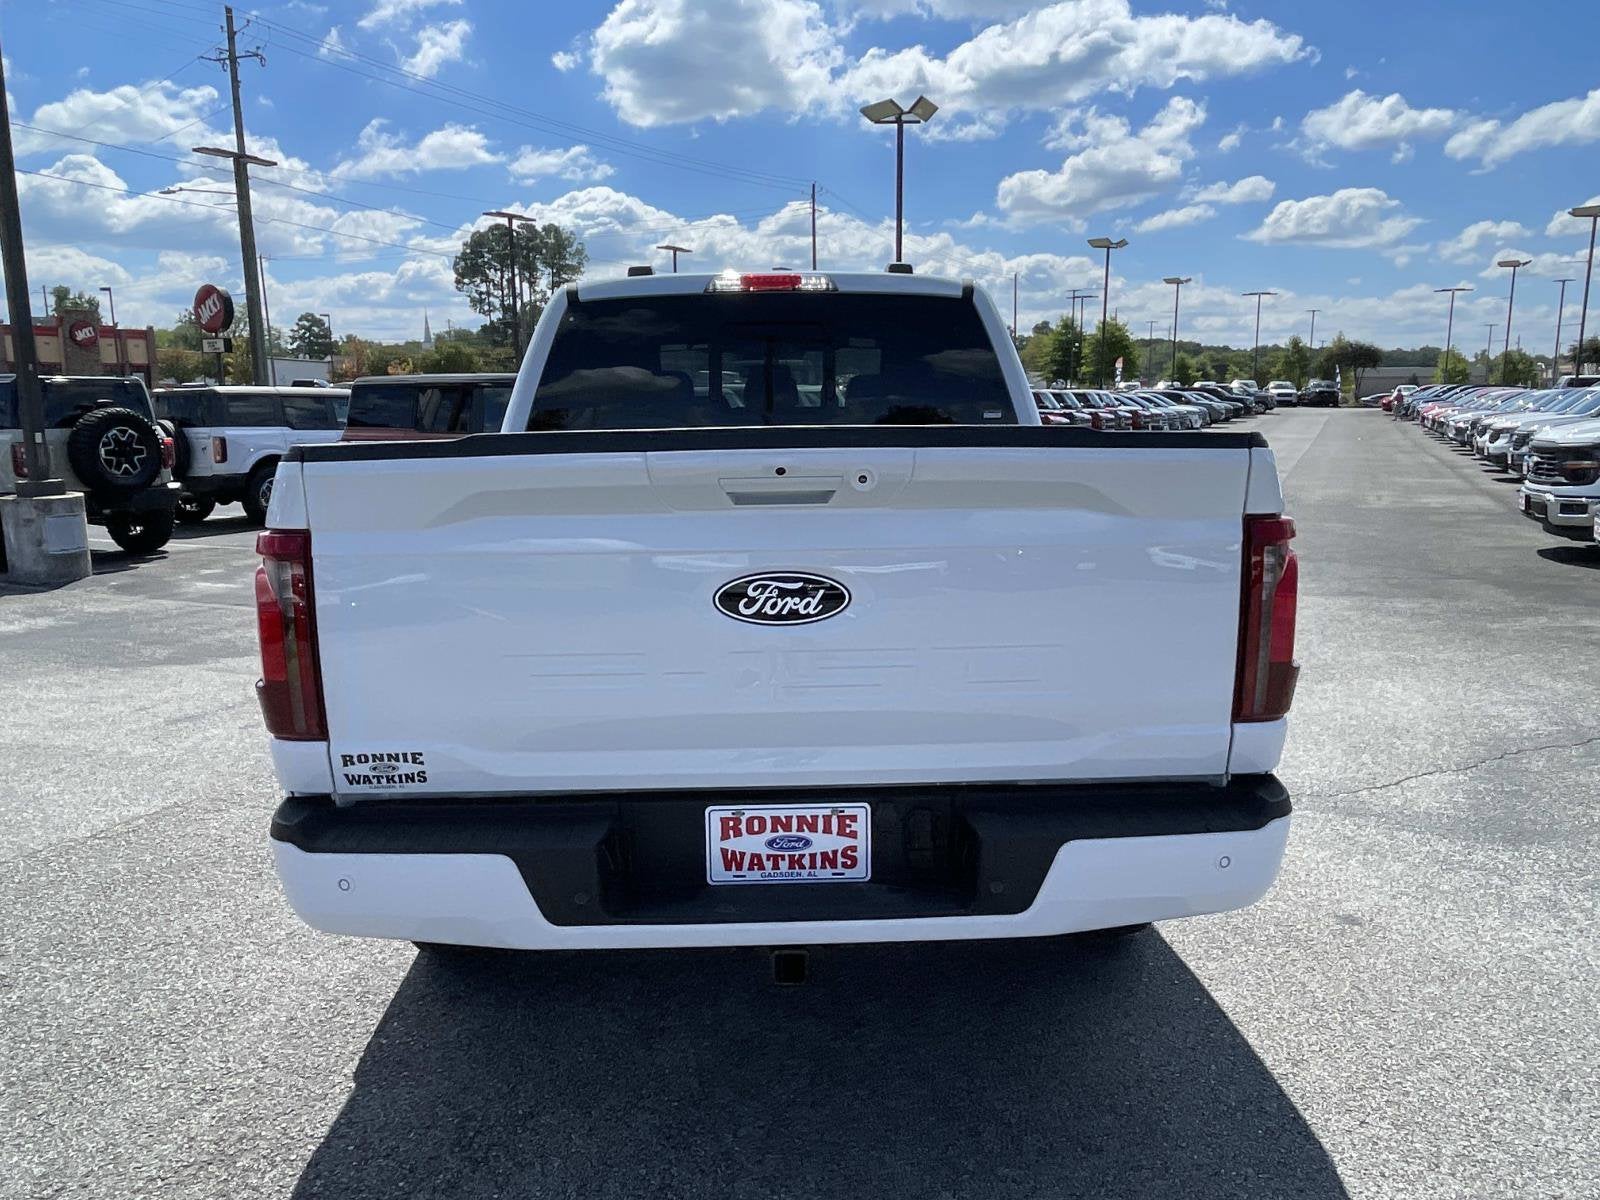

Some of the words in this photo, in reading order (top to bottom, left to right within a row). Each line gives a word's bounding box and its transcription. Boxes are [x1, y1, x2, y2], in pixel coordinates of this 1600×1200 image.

[738, 580, 825, 615] Ford
[341, 752, 425, 767] RONNIE
[343, 770, 428, 785] WATKINS
[720, 814, 858, 841] RONNIE
[773, 837, 806, 848] Ford
[720, 845, 858, 872] WATKINS
[806, 870, 818, 878] AL
